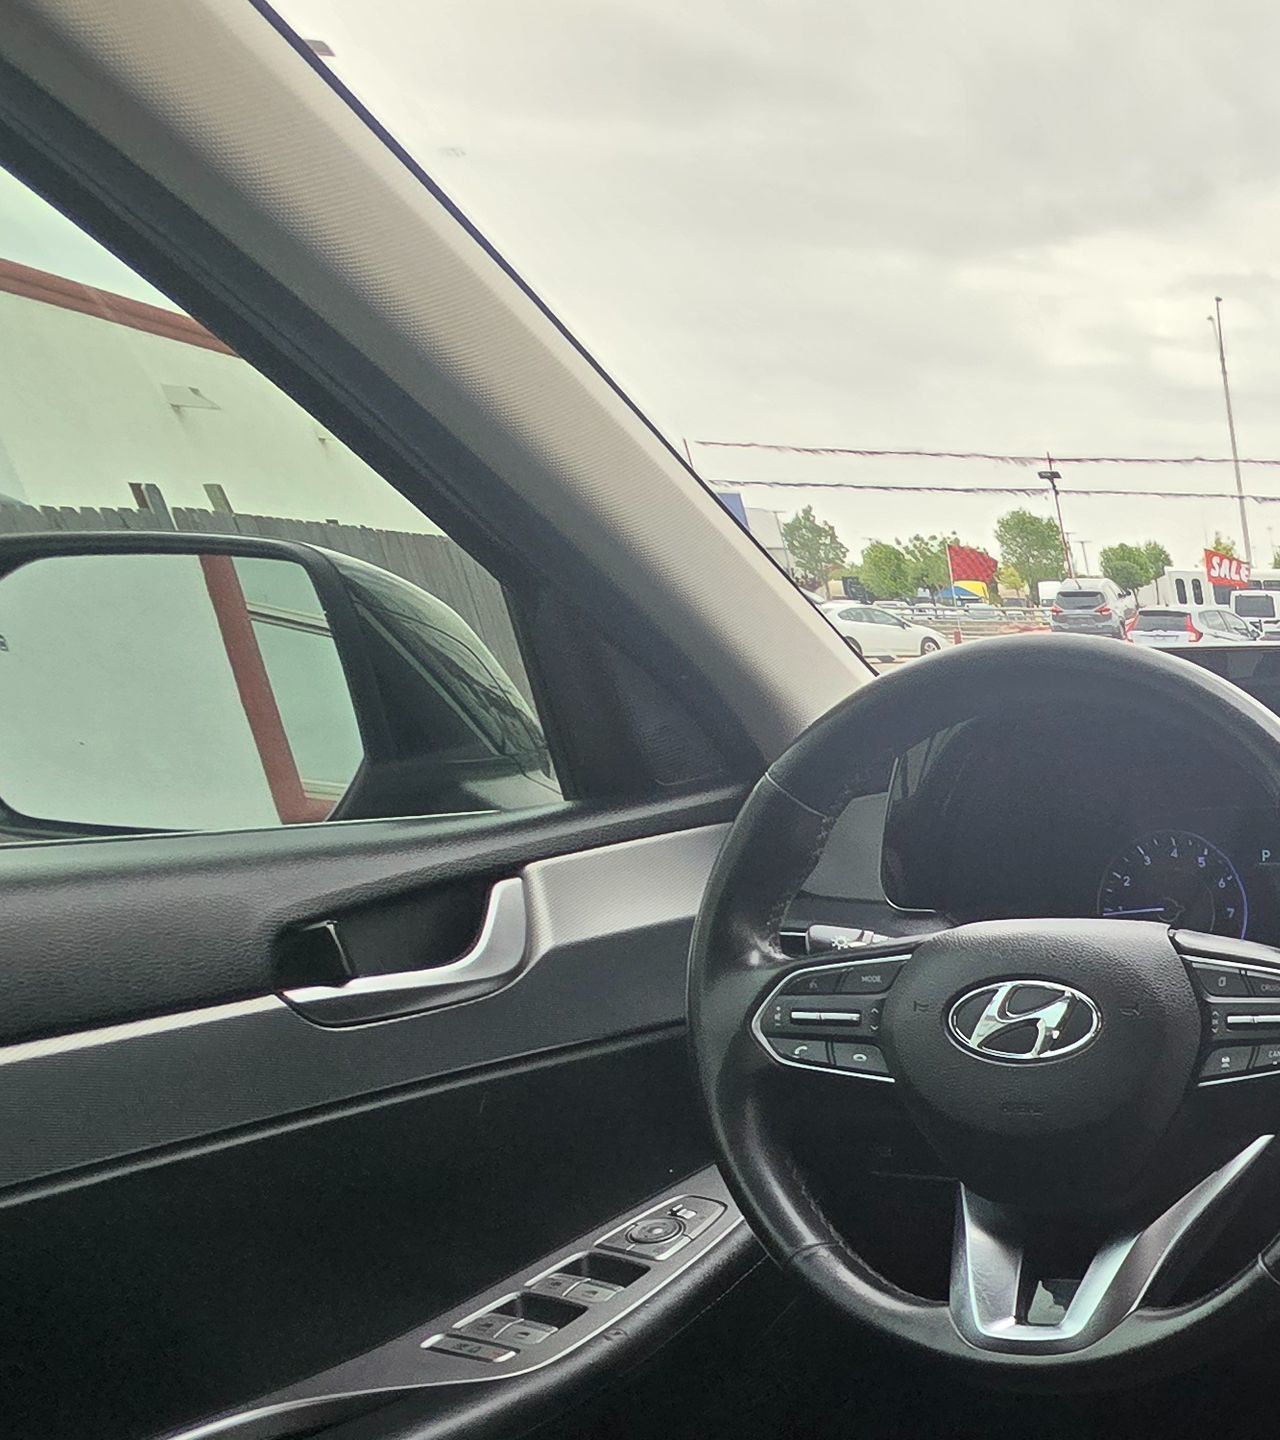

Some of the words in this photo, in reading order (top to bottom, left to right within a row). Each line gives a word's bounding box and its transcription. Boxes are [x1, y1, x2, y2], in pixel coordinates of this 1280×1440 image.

[1170, 848, 1178, 858] 4
[1262, 850, 1271, 861] P
[1144, 855, 1151, 866] 3
[1198, 857, 1206, 868] 5
[1123, 876, 1130, 887] 2
[1218, 878, 1226, 888] 6
[1227, 908, 1235, 918] 7
